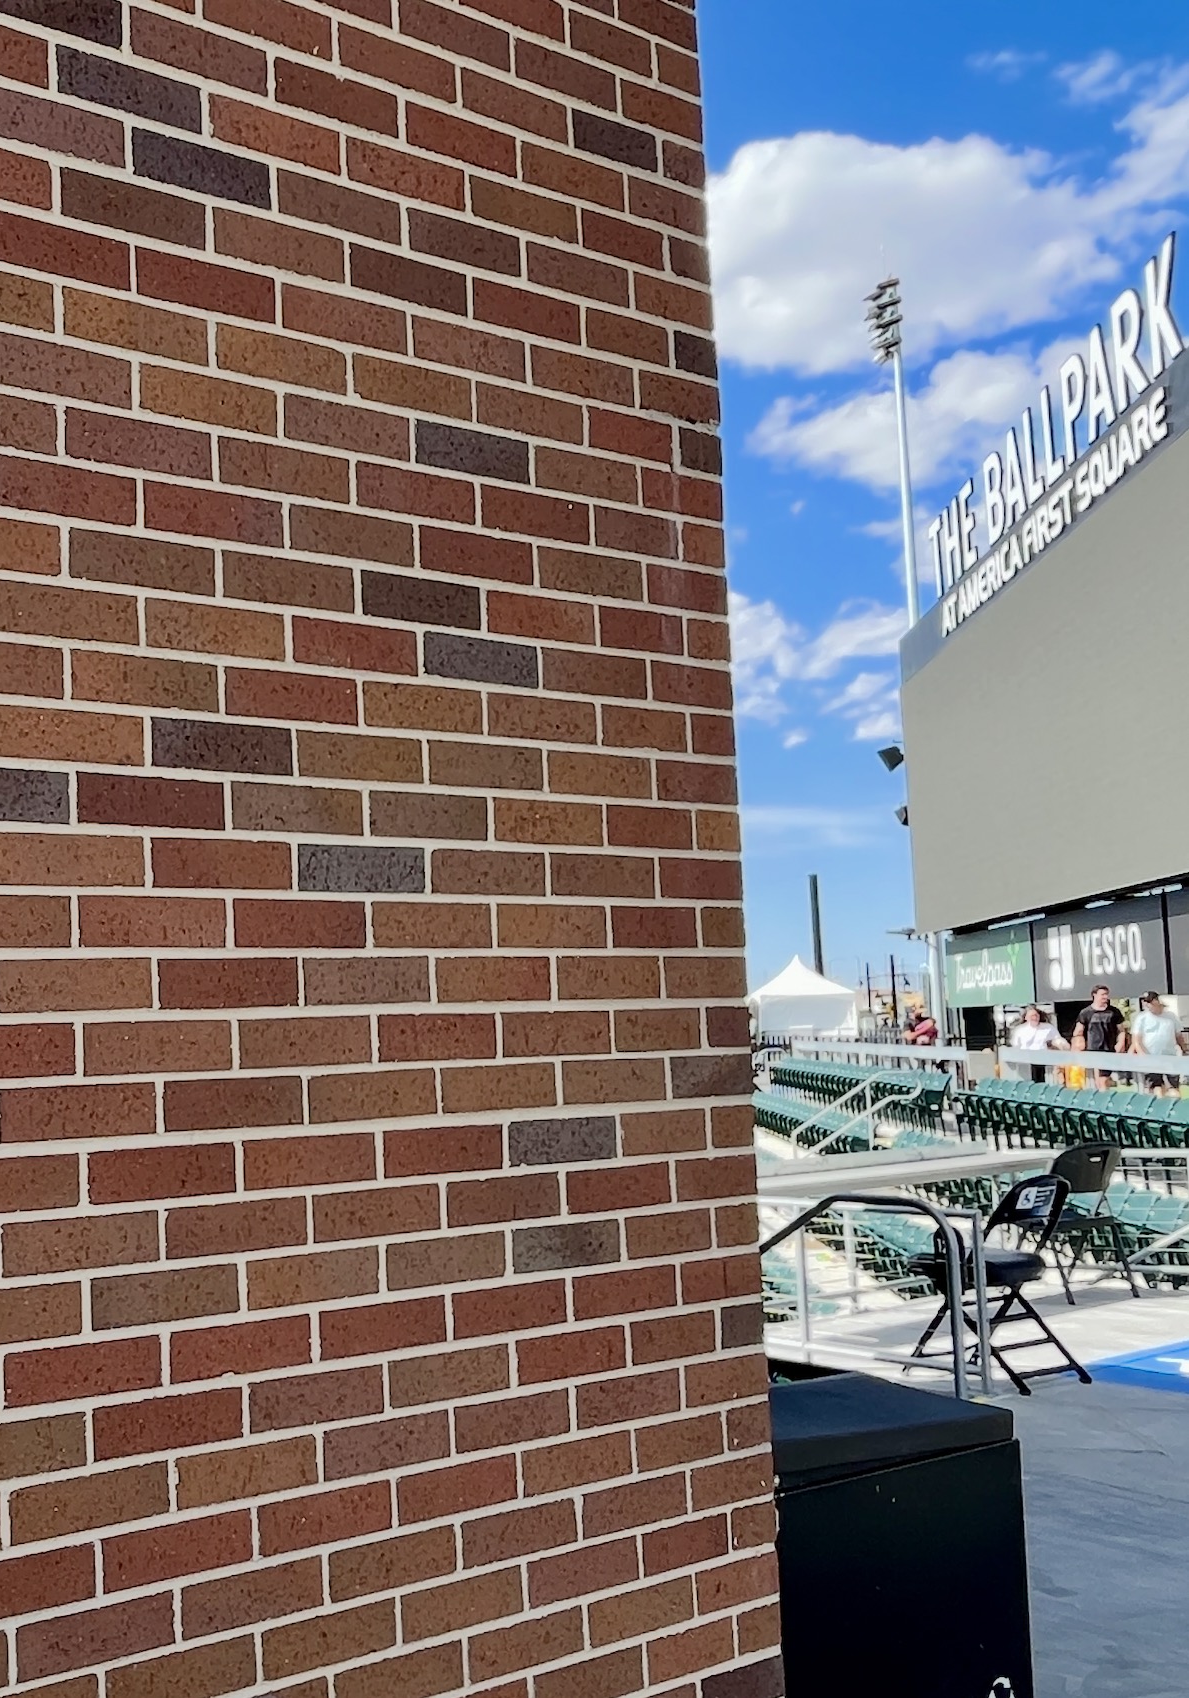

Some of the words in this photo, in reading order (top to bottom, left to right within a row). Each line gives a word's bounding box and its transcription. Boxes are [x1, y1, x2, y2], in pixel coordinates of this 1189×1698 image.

[928, 478, 978, 598] THE
[983, 231, 1185, 547] BALLPARK
[942, 593, 958, 638] AT
[958, 534, 1023, 623] AMERICA
[1022, 479, 1073, 563] FIRST
[1075, 386, 1168, 512] SQUARE
